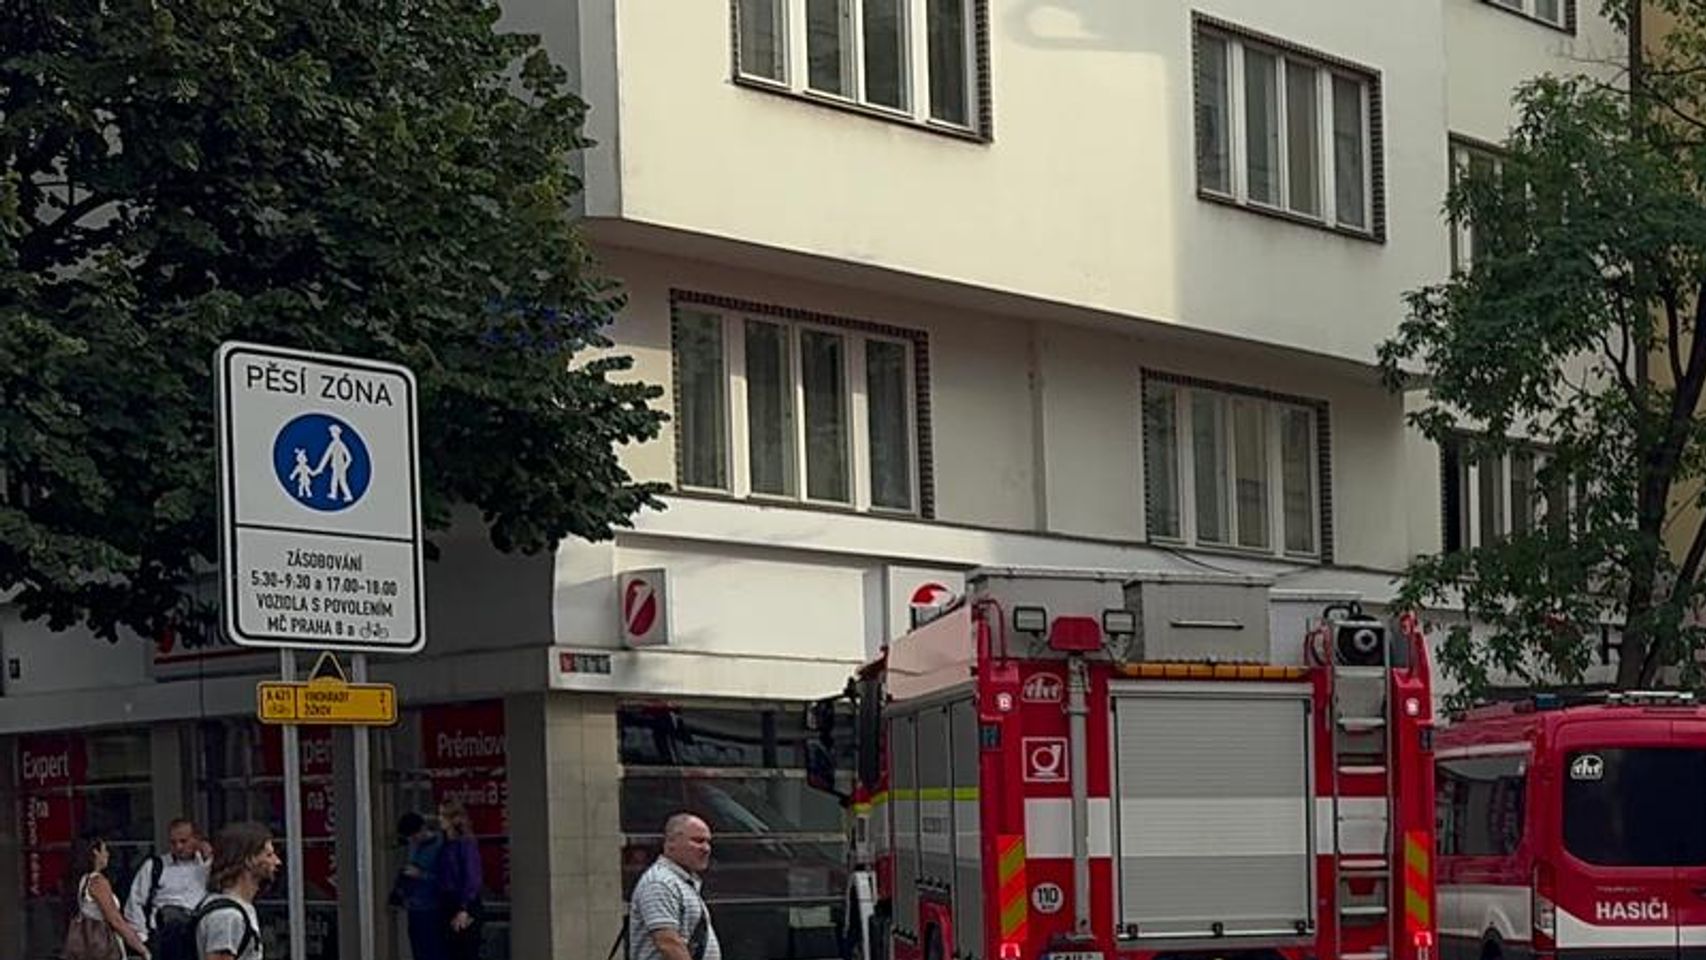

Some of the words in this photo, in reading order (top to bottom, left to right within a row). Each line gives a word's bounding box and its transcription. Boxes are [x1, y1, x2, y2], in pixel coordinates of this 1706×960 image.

[320, 373, 393, 406] ZÓNA
[286, 549, 362, 572] ZÁSOBOVÁNÍ
[314, 578, 322, 591] a
[256, 593, 308, 612] VOZIDLA
[311, 597, 321, 612] S
[324, 598, 394, 617] POVOLENÍM
[267, 615, 287, 632] MČ
[291, 618, 332, 635] PRAHA
[23, 752, 70, 785] Expert
[1038, 887, 1059, 904] 110
[1596, 898, 1668, 919] HASIČI
